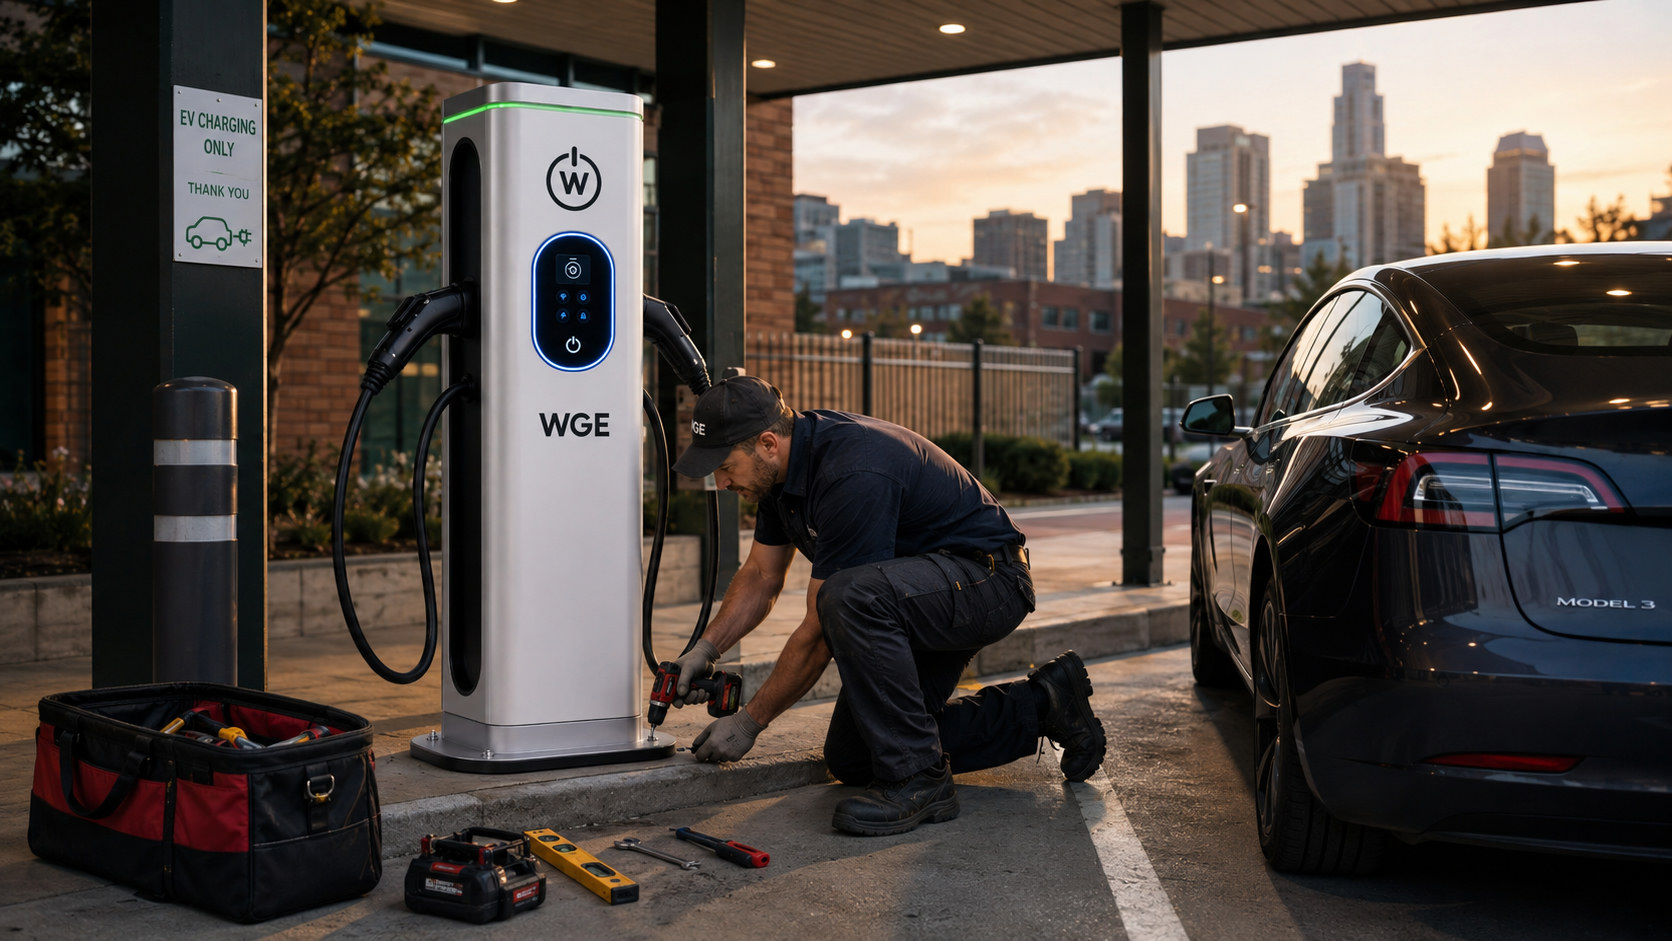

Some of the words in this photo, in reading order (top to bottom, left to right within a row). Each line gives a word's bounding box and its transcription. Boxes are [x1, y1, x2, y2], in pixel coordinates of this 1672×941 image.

[180, 109, 195, 126] EV
[198, 112, 256, 135] CHARGING
[204, 139, 235, 157] ONLY
[188, 182, 225, 198] THANK
[228, 187, 250, 200] YOU
[559, 171, 590, 196] W
[539, 412, 610, 437] WGE
[691, 419, 706, 436] GE
[1557, 597, 1636, 609] MODEL
[1641, 600, 1656, 610] 3
